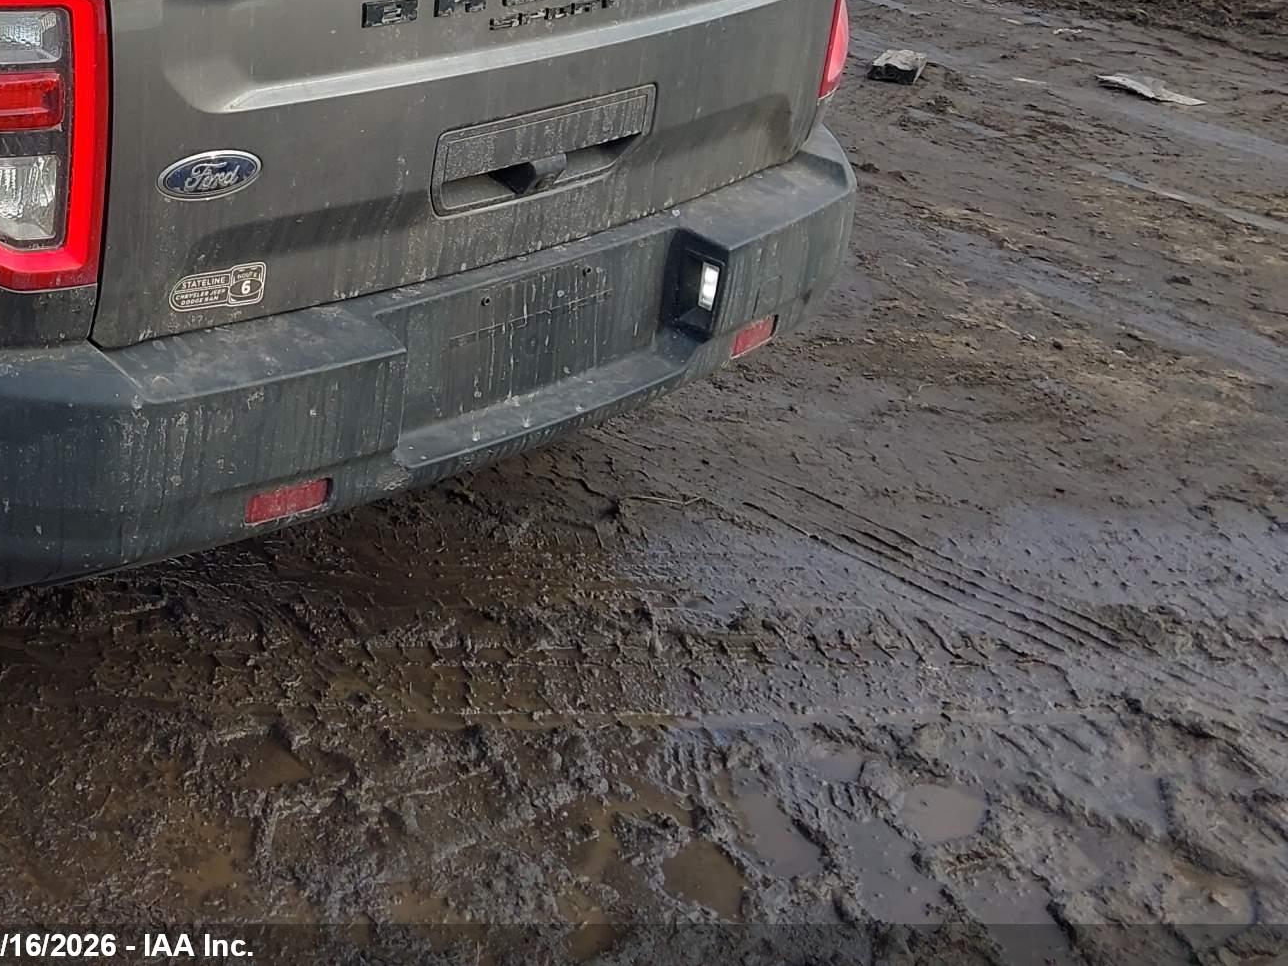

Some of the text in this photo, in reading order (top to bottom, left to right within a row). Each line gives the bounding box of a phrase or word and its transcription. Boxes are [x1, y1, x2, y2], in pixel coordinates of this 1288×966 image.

[183, 161, 241, 192] Ford
[181, 276, 226, 290] STATELINE
[241, 280, 251, 294] 6
[175, 290, 209, 301] CHRYSLER
[181, 297, 203, 306] DODGE
